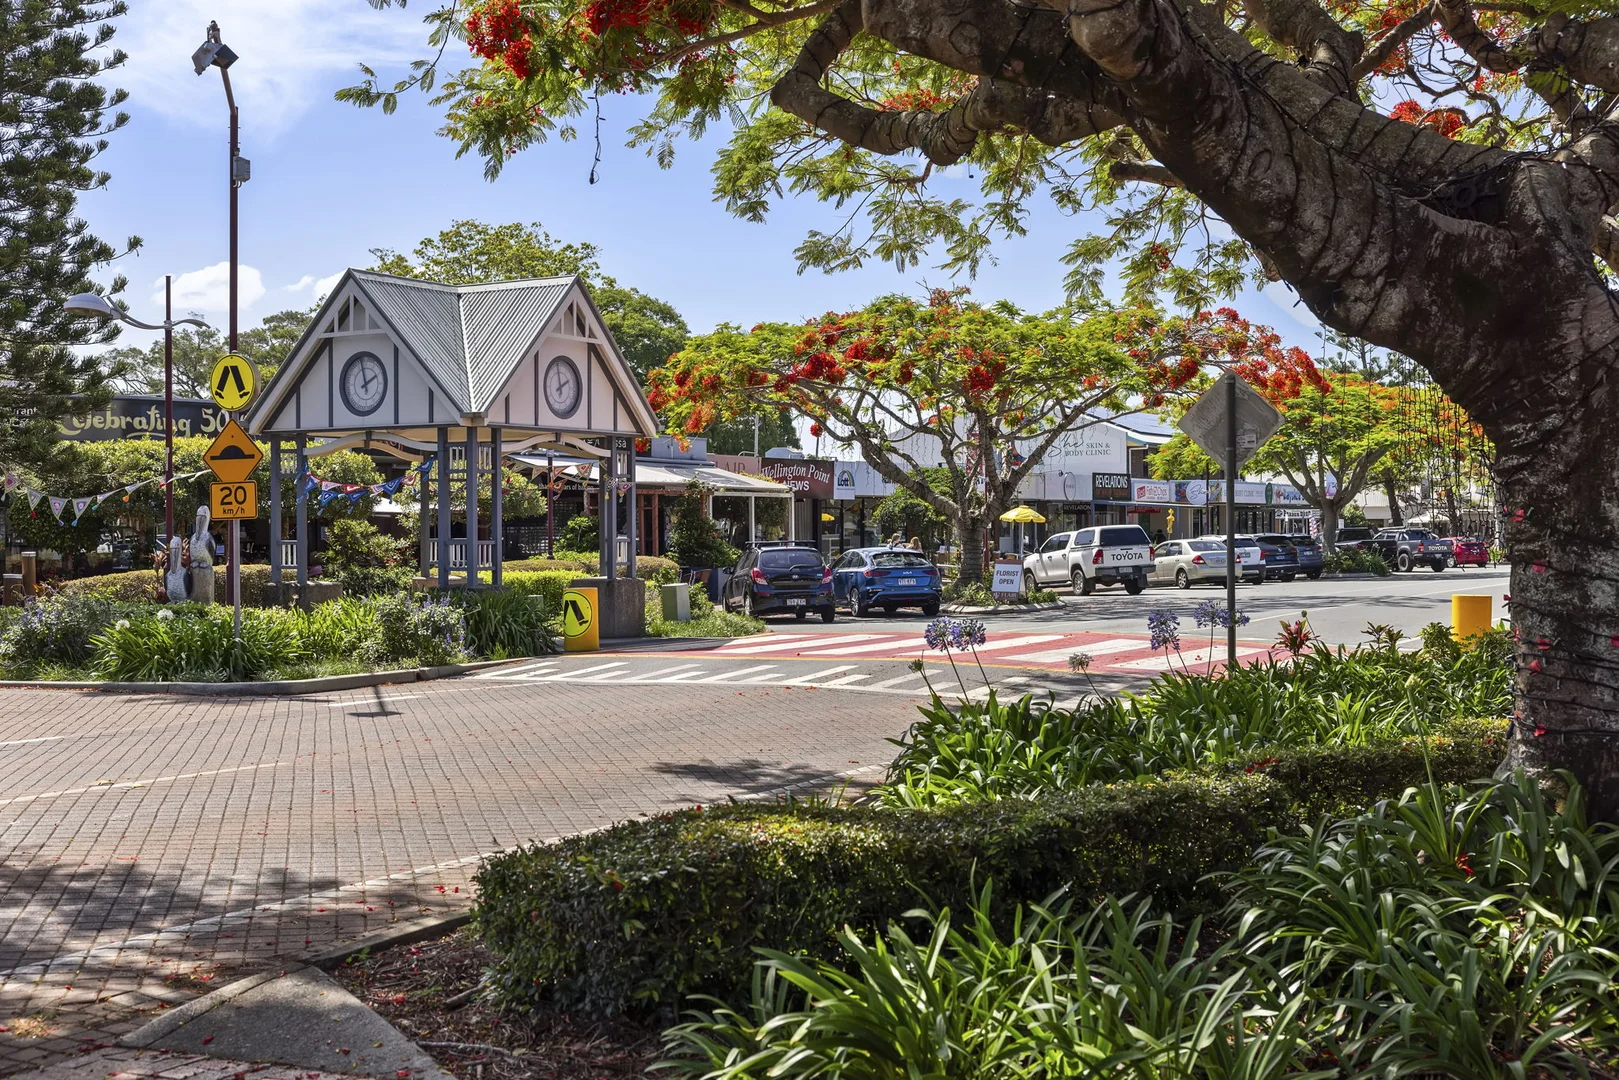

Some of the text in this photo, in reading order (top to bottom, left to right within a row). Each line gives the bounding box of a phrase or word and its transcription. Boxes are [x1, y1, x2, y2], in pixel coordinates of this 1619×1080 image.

[761, 462, 831, 484] Wellington Point
[783, 480, 810, 492] NEWS
[1095, 475, 1128, 488] REVELATIONS
[220, 485, 247, 506] 20
[222, 506, 246, 517] km/h
[1111, 552, 1144, 561] TOYOTA
